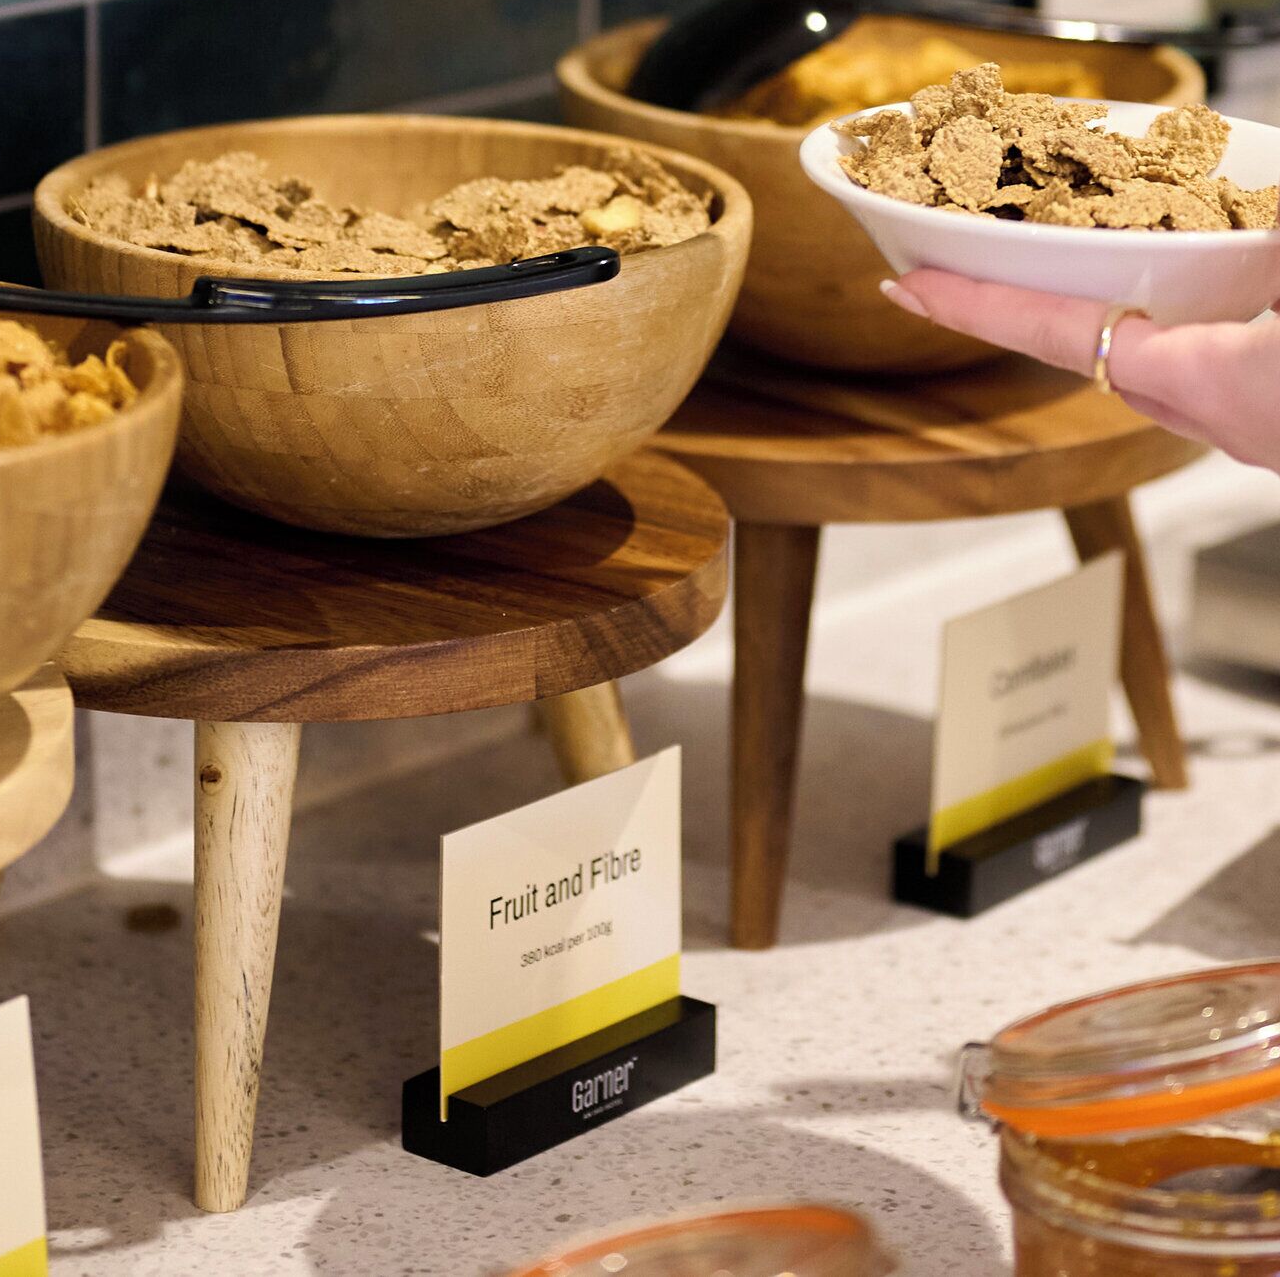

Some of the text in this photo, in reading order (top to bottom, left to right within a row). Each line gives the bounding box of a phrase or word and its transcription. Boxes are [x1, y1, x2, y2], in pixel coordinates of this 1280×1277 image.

[489, 848, 642, 930] Fruit and Fibre
[544, 938, 565, 958] kcal
[567, 933, 586, 952] per
[572, 1061, 634, 1113] Garner
